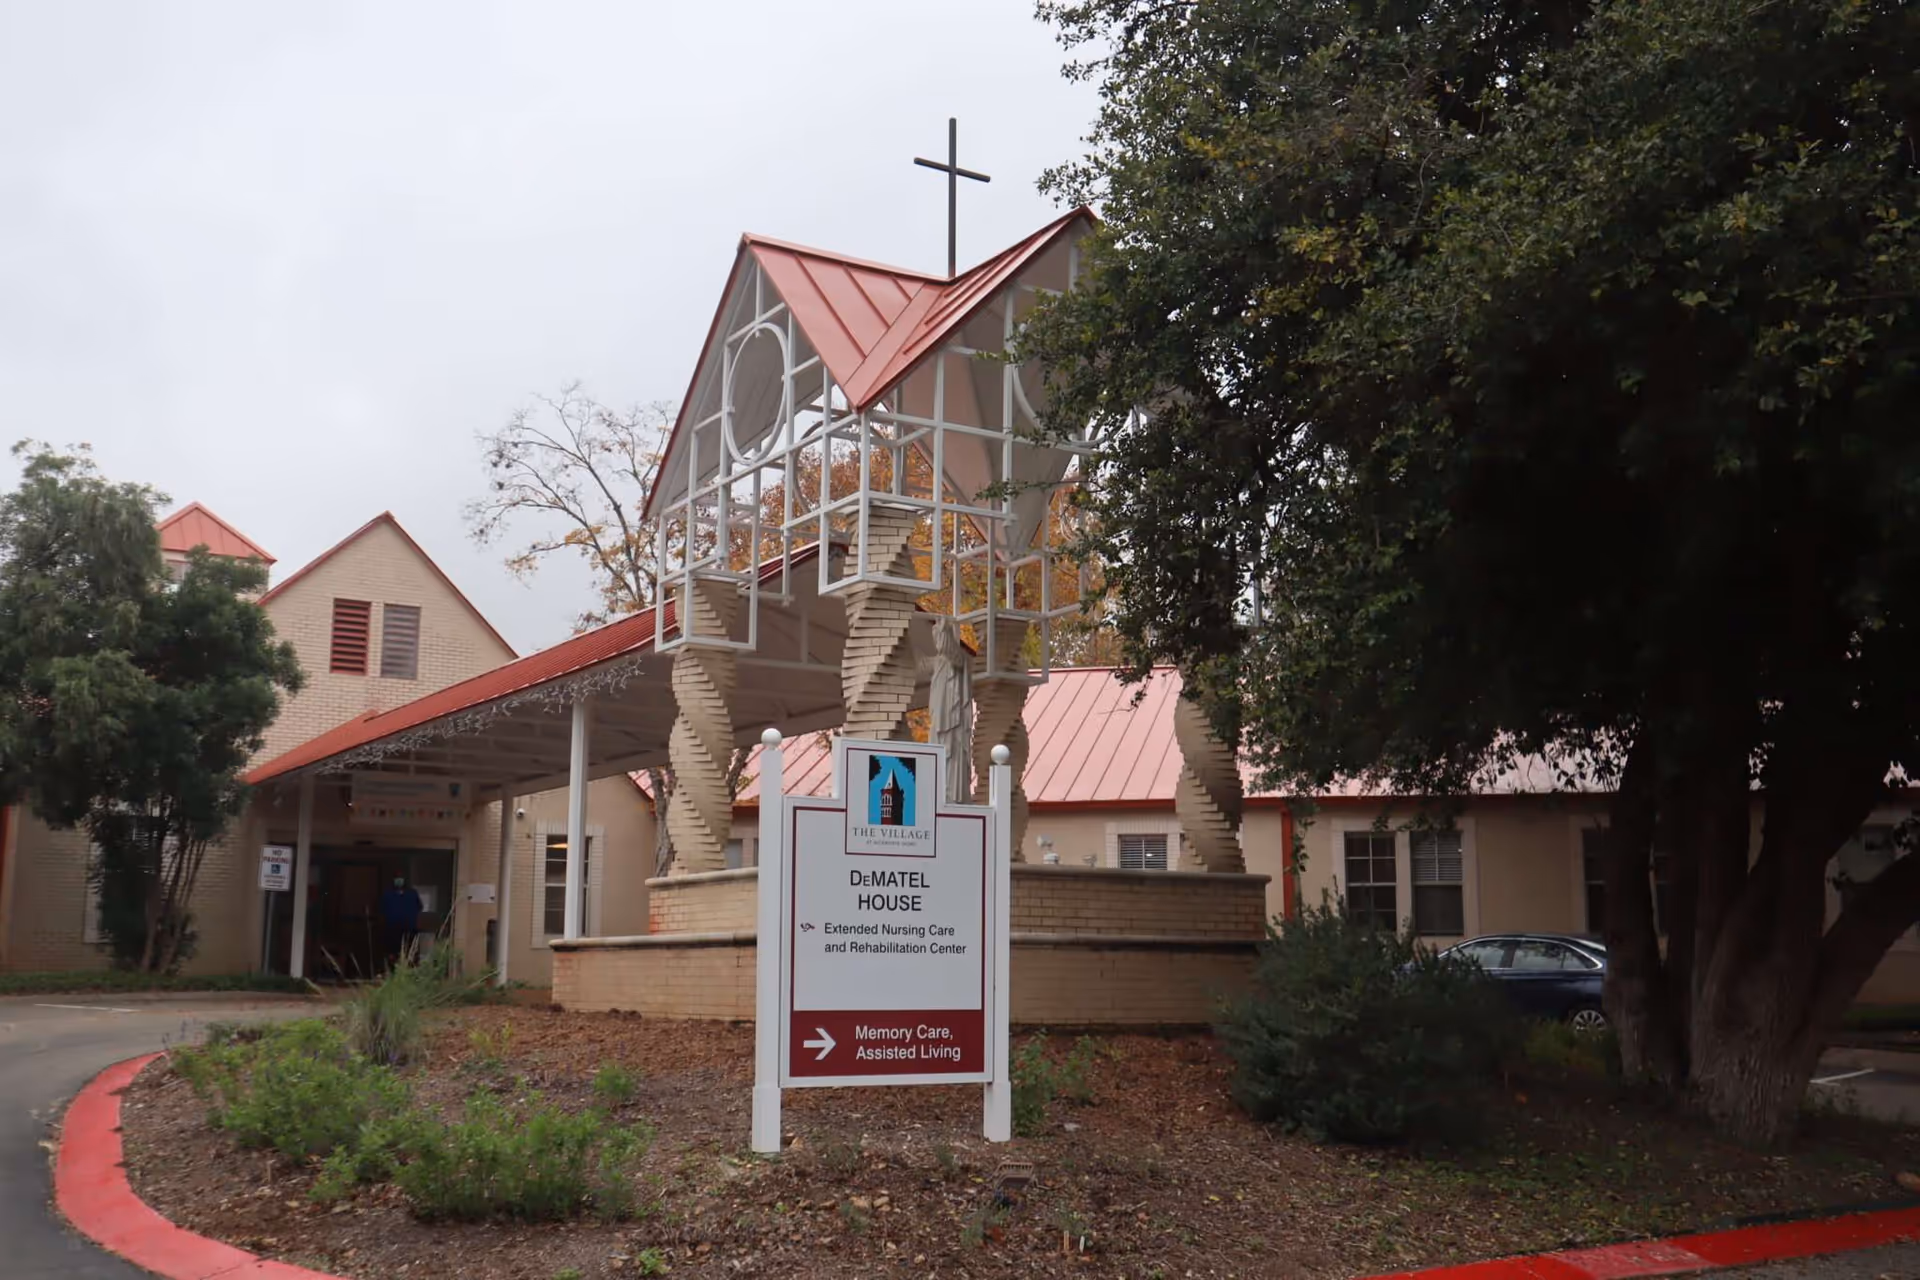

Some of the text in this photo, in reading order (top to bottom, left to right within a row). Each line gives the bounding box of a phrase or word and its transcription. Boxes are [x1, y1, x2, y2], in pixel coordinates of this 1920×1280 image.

[853, 827, 931, 840] THE VILLAGE
[858, 893, 922, 911] HOUSE
[824, 922, 955, 938] Extended Nursing Care
[824, 941, 967, 954] and Rehabilitation Center
[855, 1024, 953, 1043] Memory Care,
[856, 1044, 961, 1062] Assisted Living
